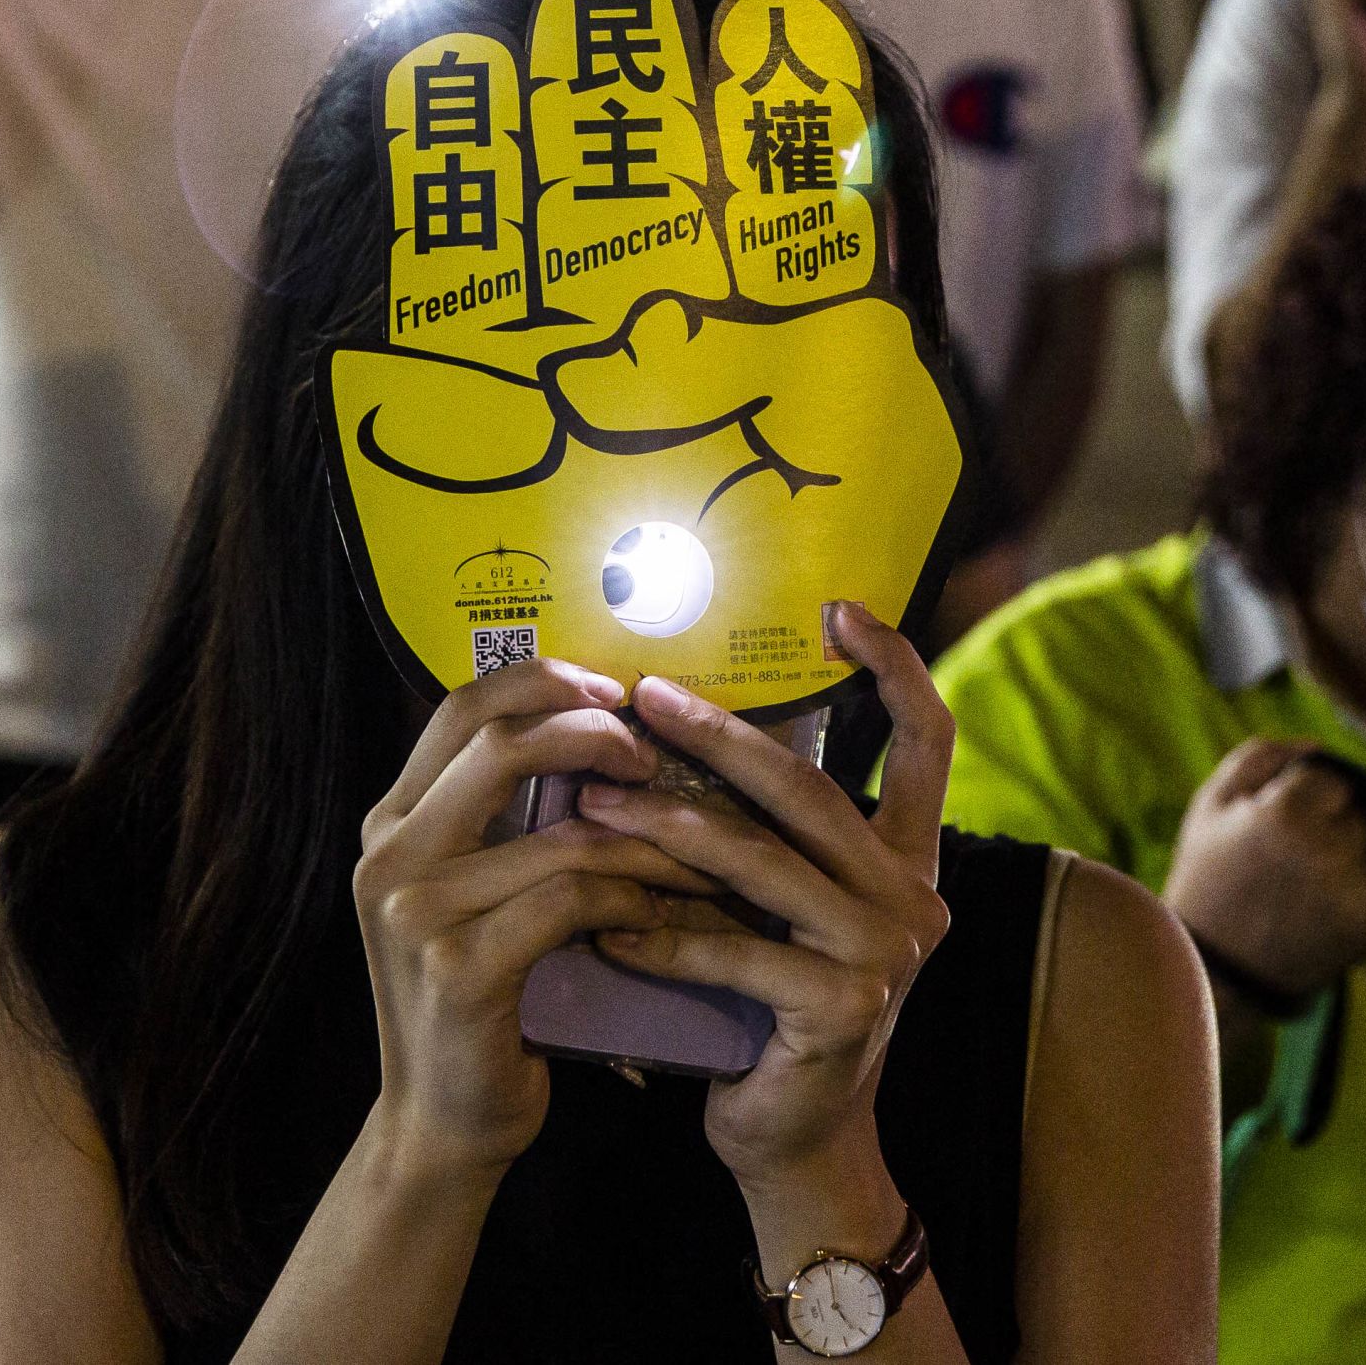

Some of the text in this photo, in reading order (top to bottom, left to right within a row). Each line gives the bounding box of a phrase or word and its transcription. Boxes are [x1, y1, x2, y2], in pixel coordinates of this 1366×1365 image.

[740, 7, 838, 194] 人權
[414, 51, 498, 255] 自由
[545, 208, 704, 284] Democracy
[740, 200, 834, 254] Human
[776, 232, 861, 283] Rights
[396, 268, 522, 334] Freedom
[490, 566, 513, 579] 612
[455, 594, 553, 608] donate.612fund.hk
[469, 606, 540, 622] 月捐支援基金
